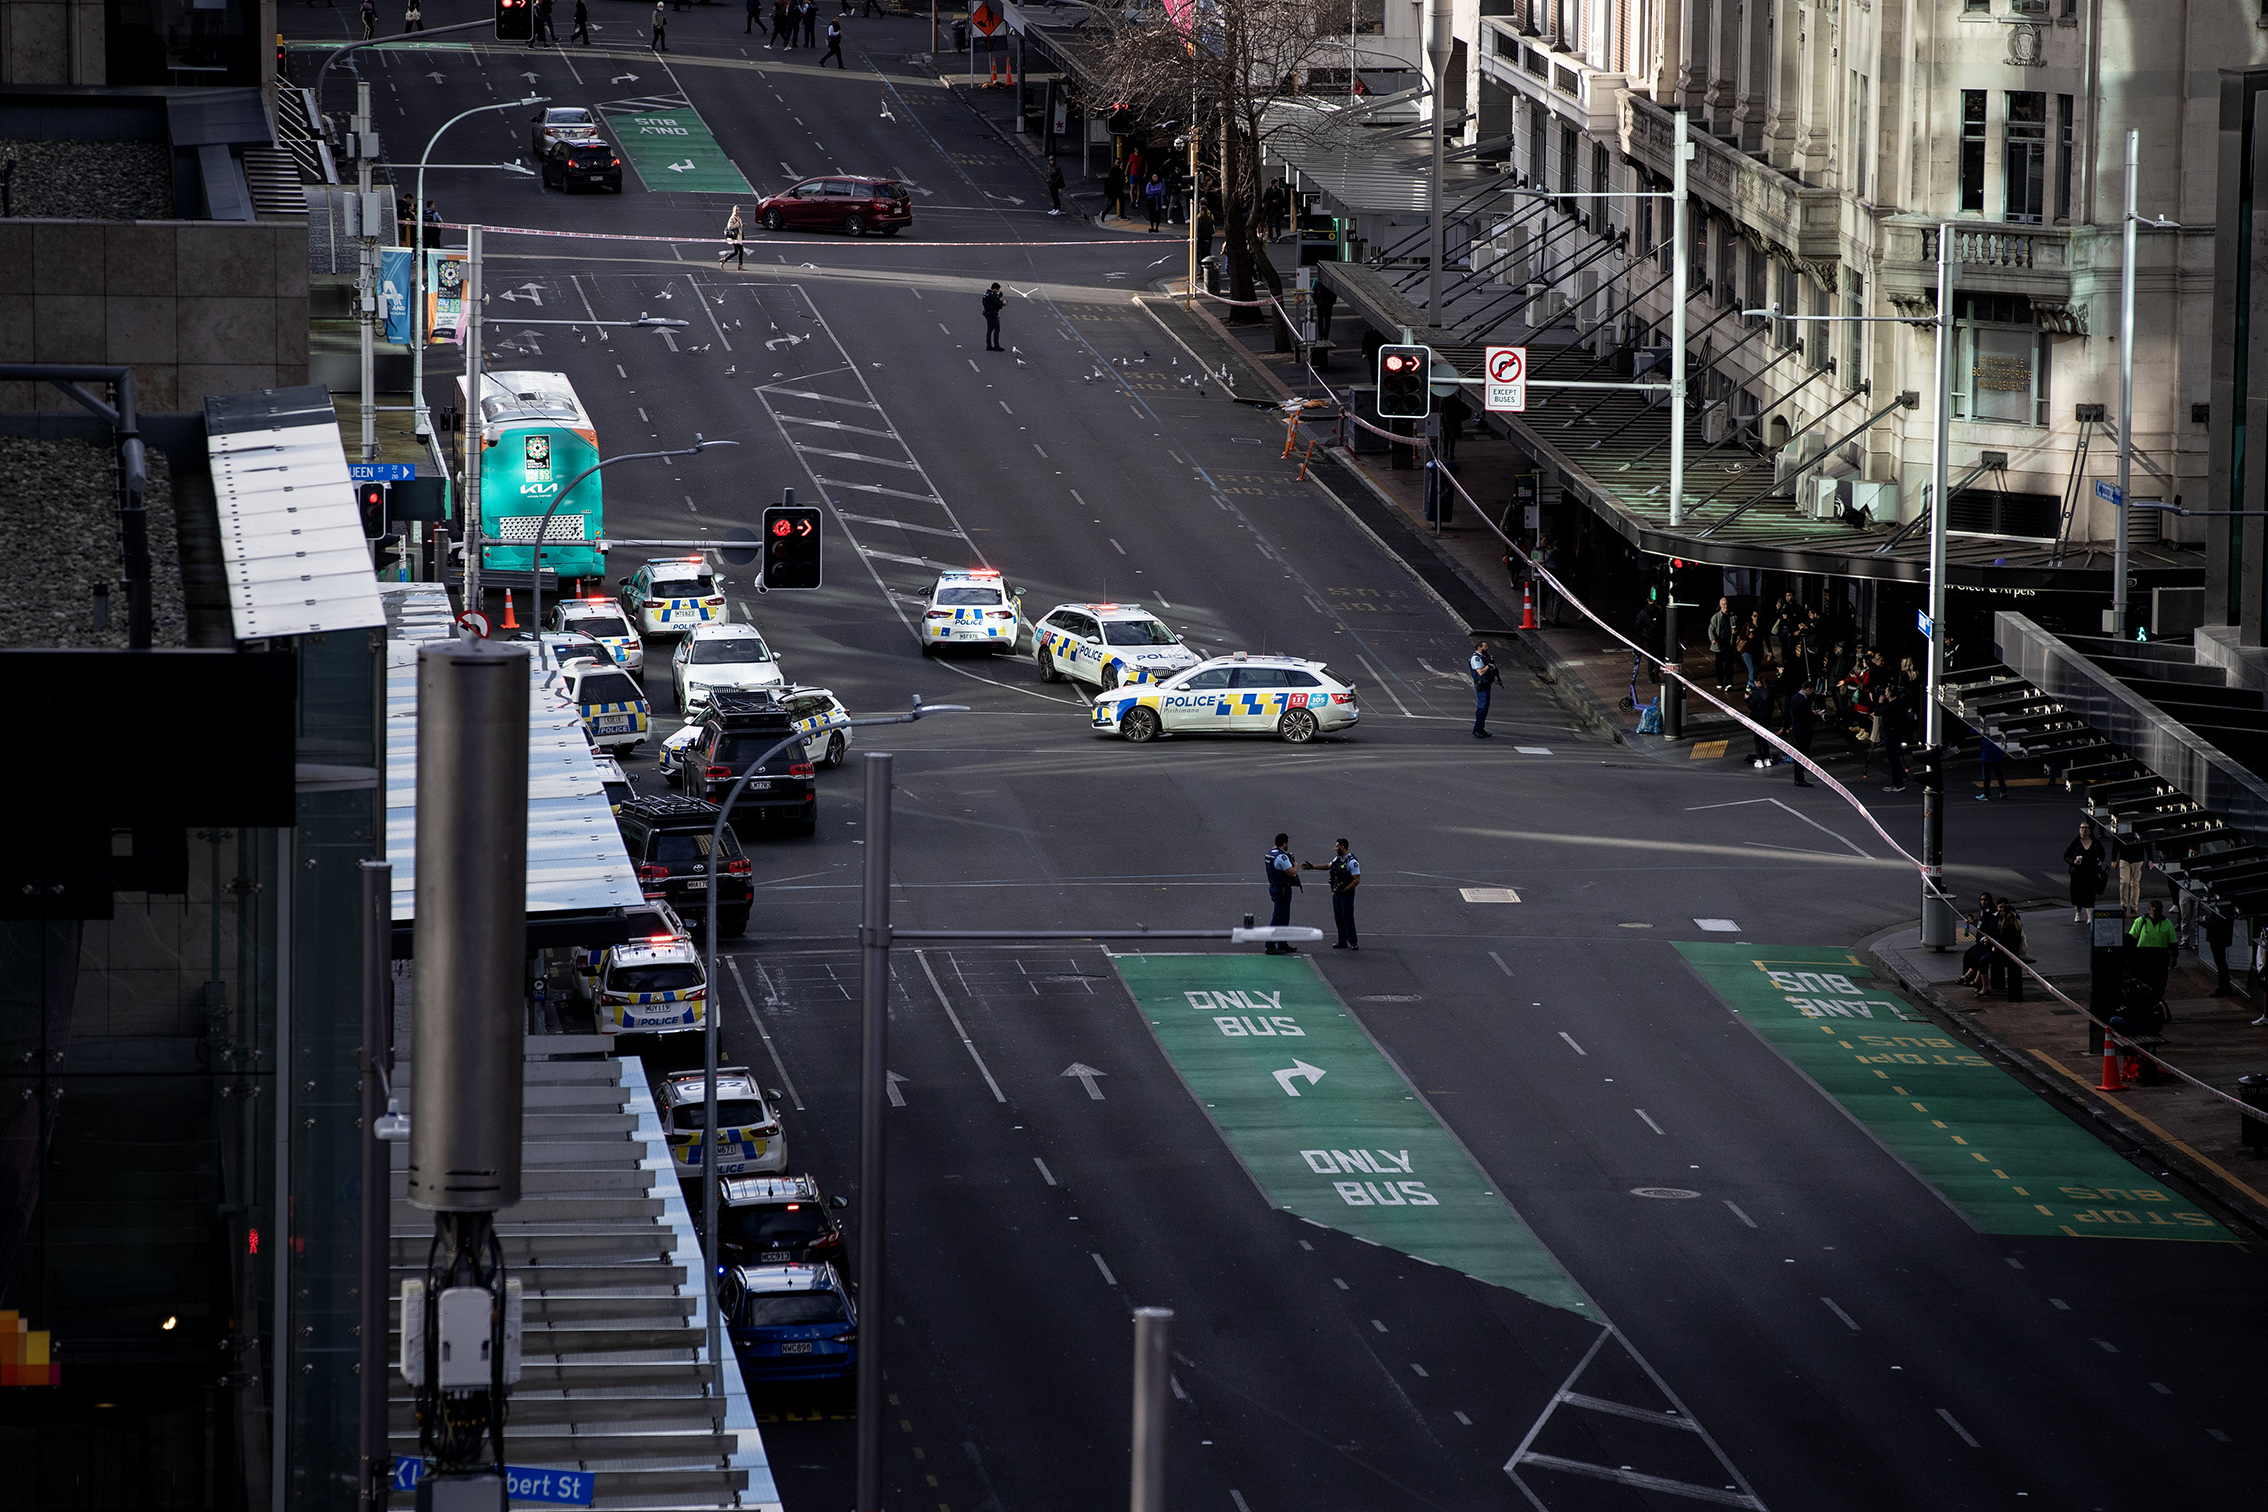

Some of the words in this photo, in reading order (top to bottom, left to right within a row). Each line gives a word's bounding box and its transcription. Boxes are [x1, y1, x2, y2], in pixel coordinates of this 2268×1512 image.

[634, 118, 678, 126] BUS
[640, 126, 689, 135] ONLY
[1972, 367, 1991, 378] BODY
[1991, 368, 2032, 380] CORPORATE
[1978, 379, 2025, 391] MANAGEMENT
[1493, 388, 1517, 396] EXCEPT
[349, 467, 373, 478] UEEN
[1079, 645, 1103, 661] POLICE
[1165, 695, 1217, 708] POLICE
[600, 725, 628, 734] POLICE
[1766, 971, 1865, 995] BUS
[1183, 990, 1283, 1010] ONLY
[1784, 996, 1909, 1021] LANE
[640, 1016, 679, 1026] POLICE
[1212, 1016, 1306, 1037] BUS
[1857, 1035, 1956, 1049] BUS
[1869, 1053, 1993, 1067] STOP
[1299, 1149, 1414, 1174] ONLY
[717, 1163, 745, 1174] LICE
[1332, 1181, 1440, 1206] BUS
[2058, 1187, 2171, 1202] BUS
[2073, 1210, 2216, 1227] STOP
[762, 1253, 789, 1261] NCC913
[783, 1344, 812, 1353] NWC898
[557, 1476, 581, 1499] St
